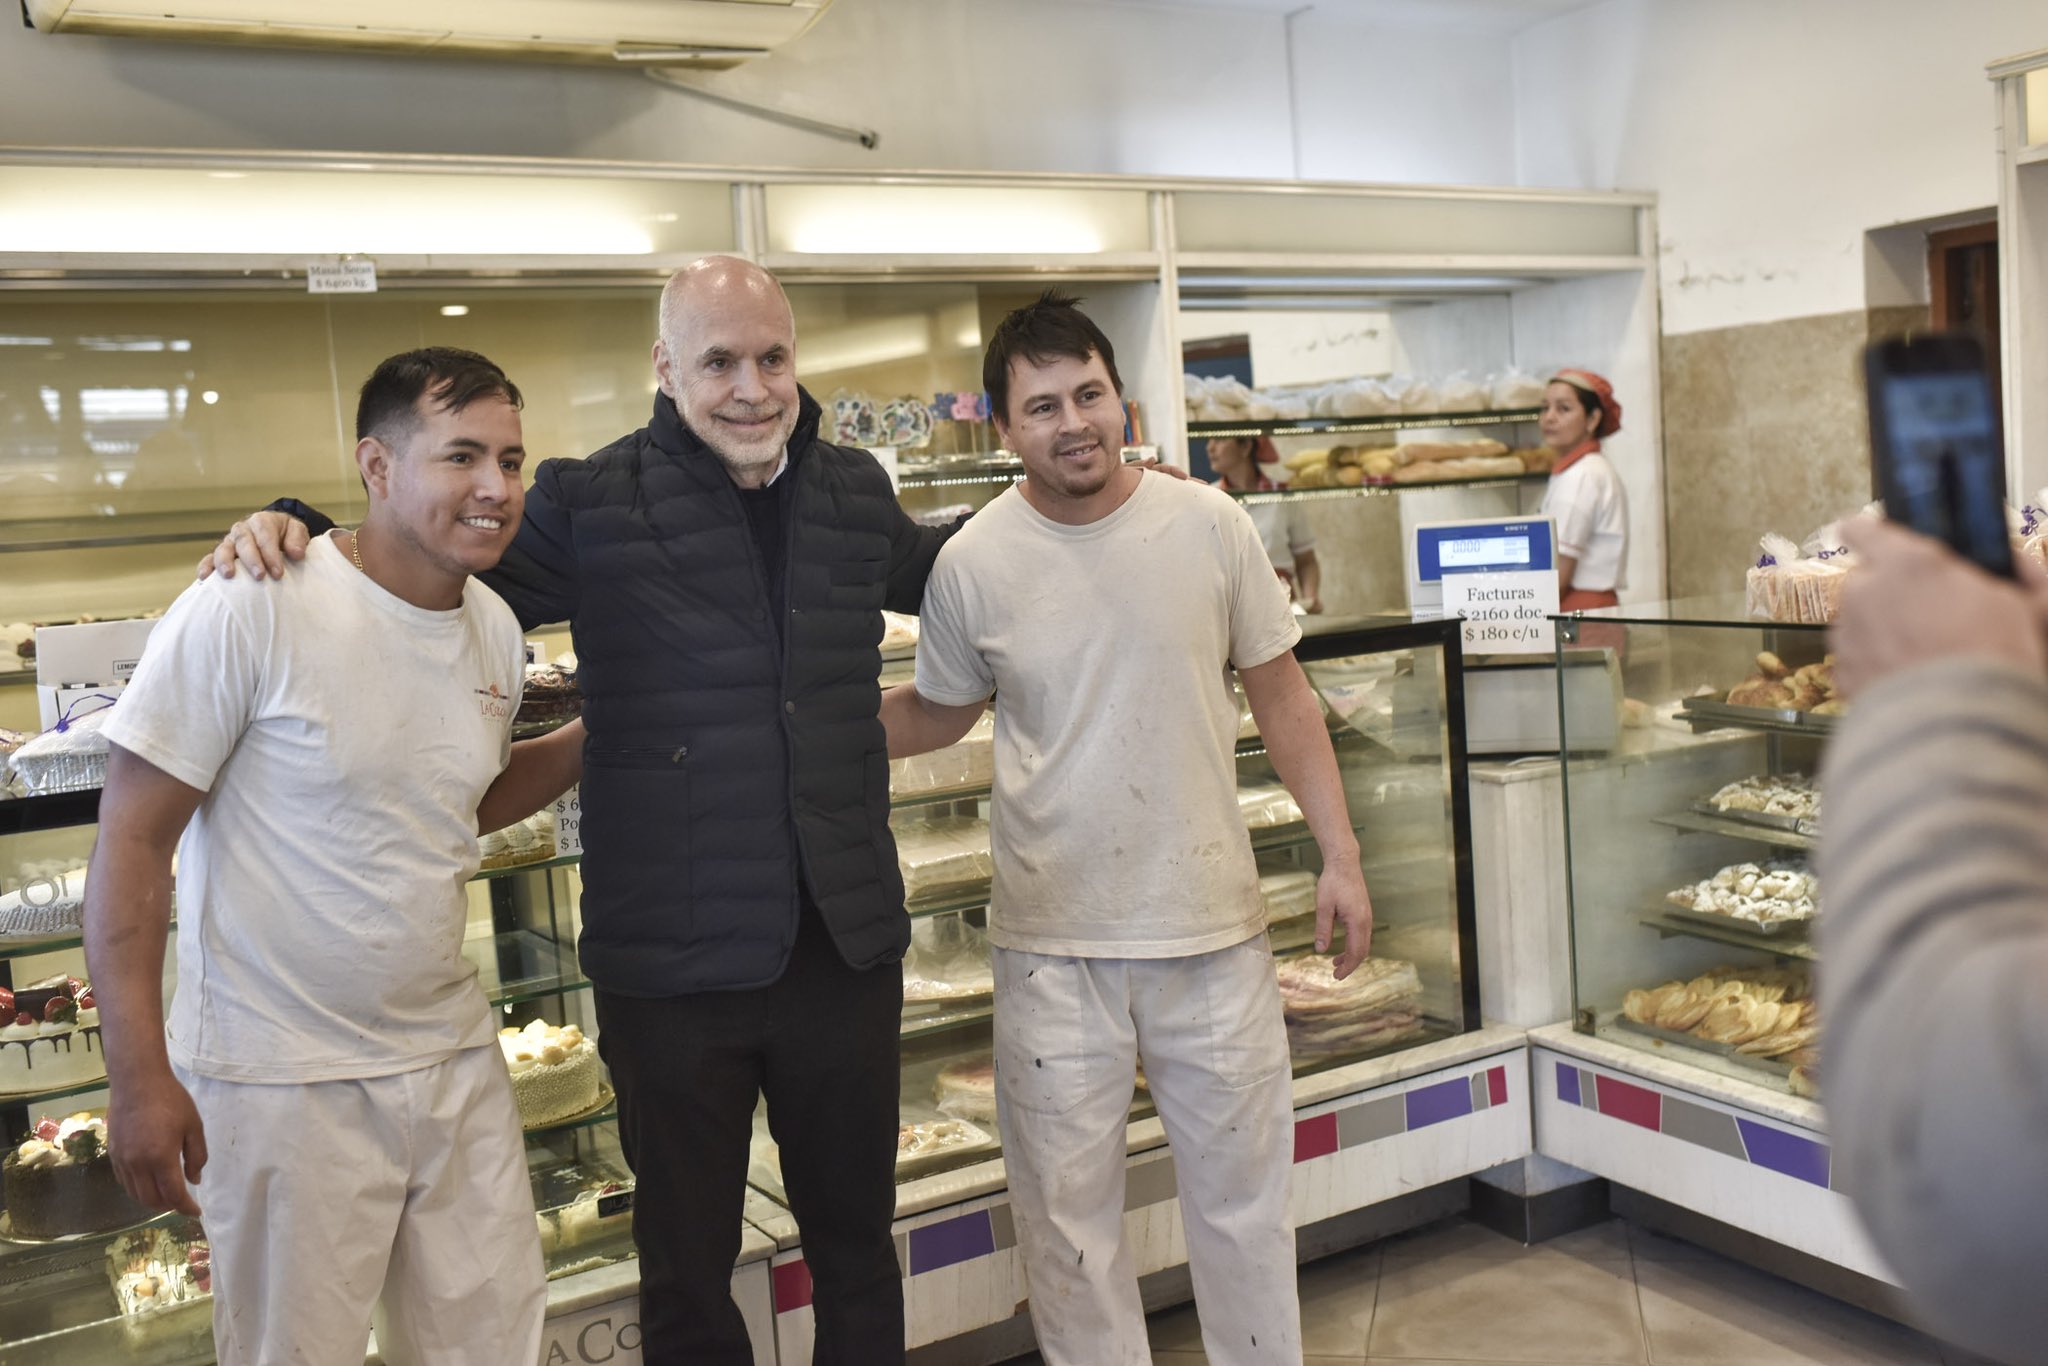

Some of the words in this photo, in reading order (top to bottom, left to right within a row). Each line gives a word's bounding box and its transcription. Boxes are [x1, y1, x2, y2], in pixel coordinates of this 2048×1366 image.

[1467, 587, 1535, 602] Facturas
[1471, 606, 1509, 621] 2160
[1465, 625, 1475, 641] $
[1481, 625, 1508, 641] 180
[1513, 624, 1539, 642] c/u
[556, 799, 566, 816] $
[570, 797, 579, 811] 6
[560, 817, 579, 831] Po
[560, 836, 570, 852] $
[574, 837, 580, 848] 1
